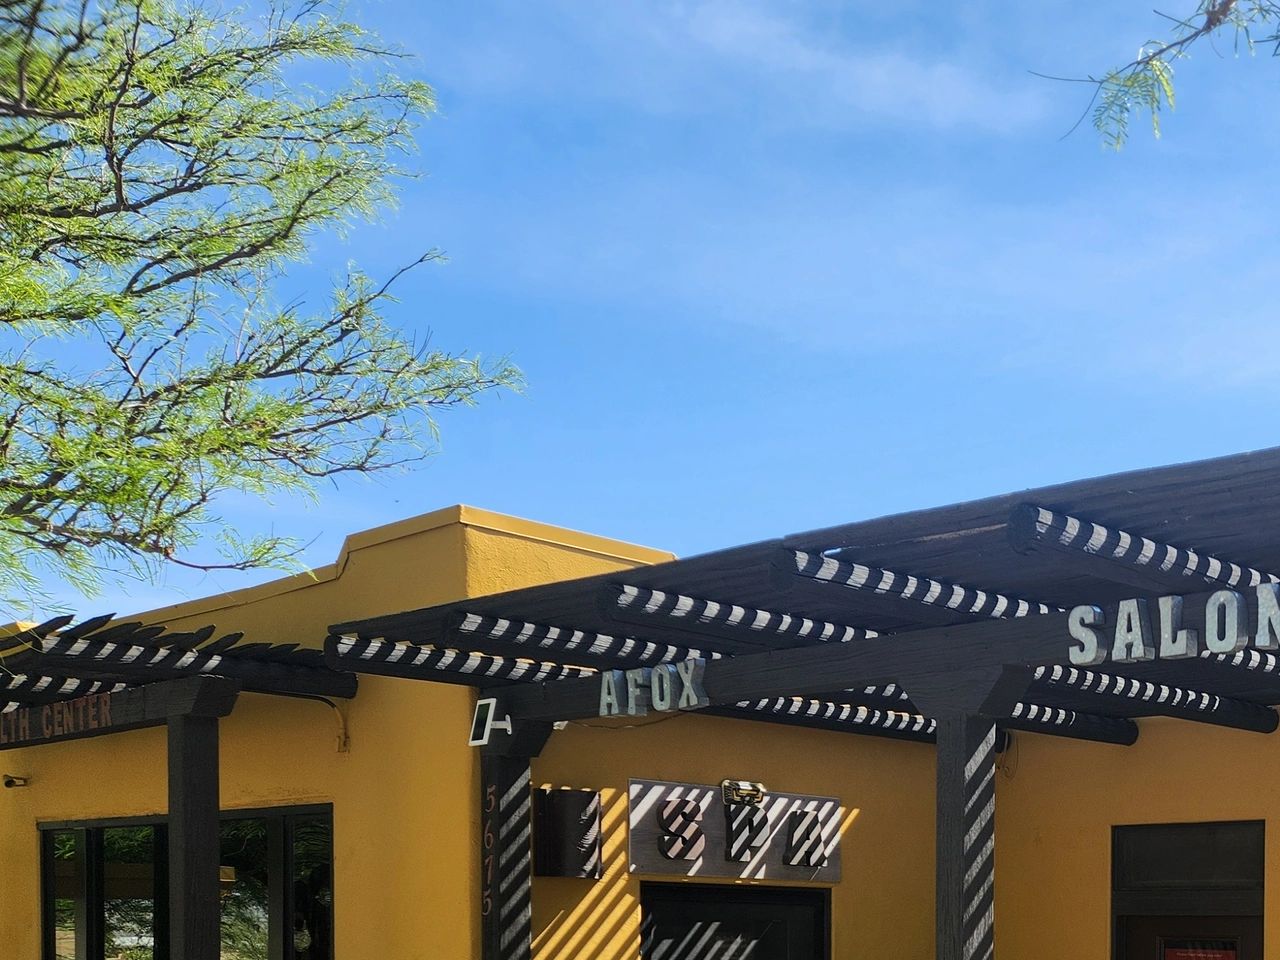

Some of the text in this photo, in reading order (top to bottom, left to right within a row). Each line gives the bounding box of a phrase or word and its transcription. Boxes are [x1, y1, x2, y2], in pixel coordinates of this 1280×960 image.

[43, 692, 113, 738] CENTER
[600, 657, 706, 716] AFOX
[657, 799, 827, 867] SPA
